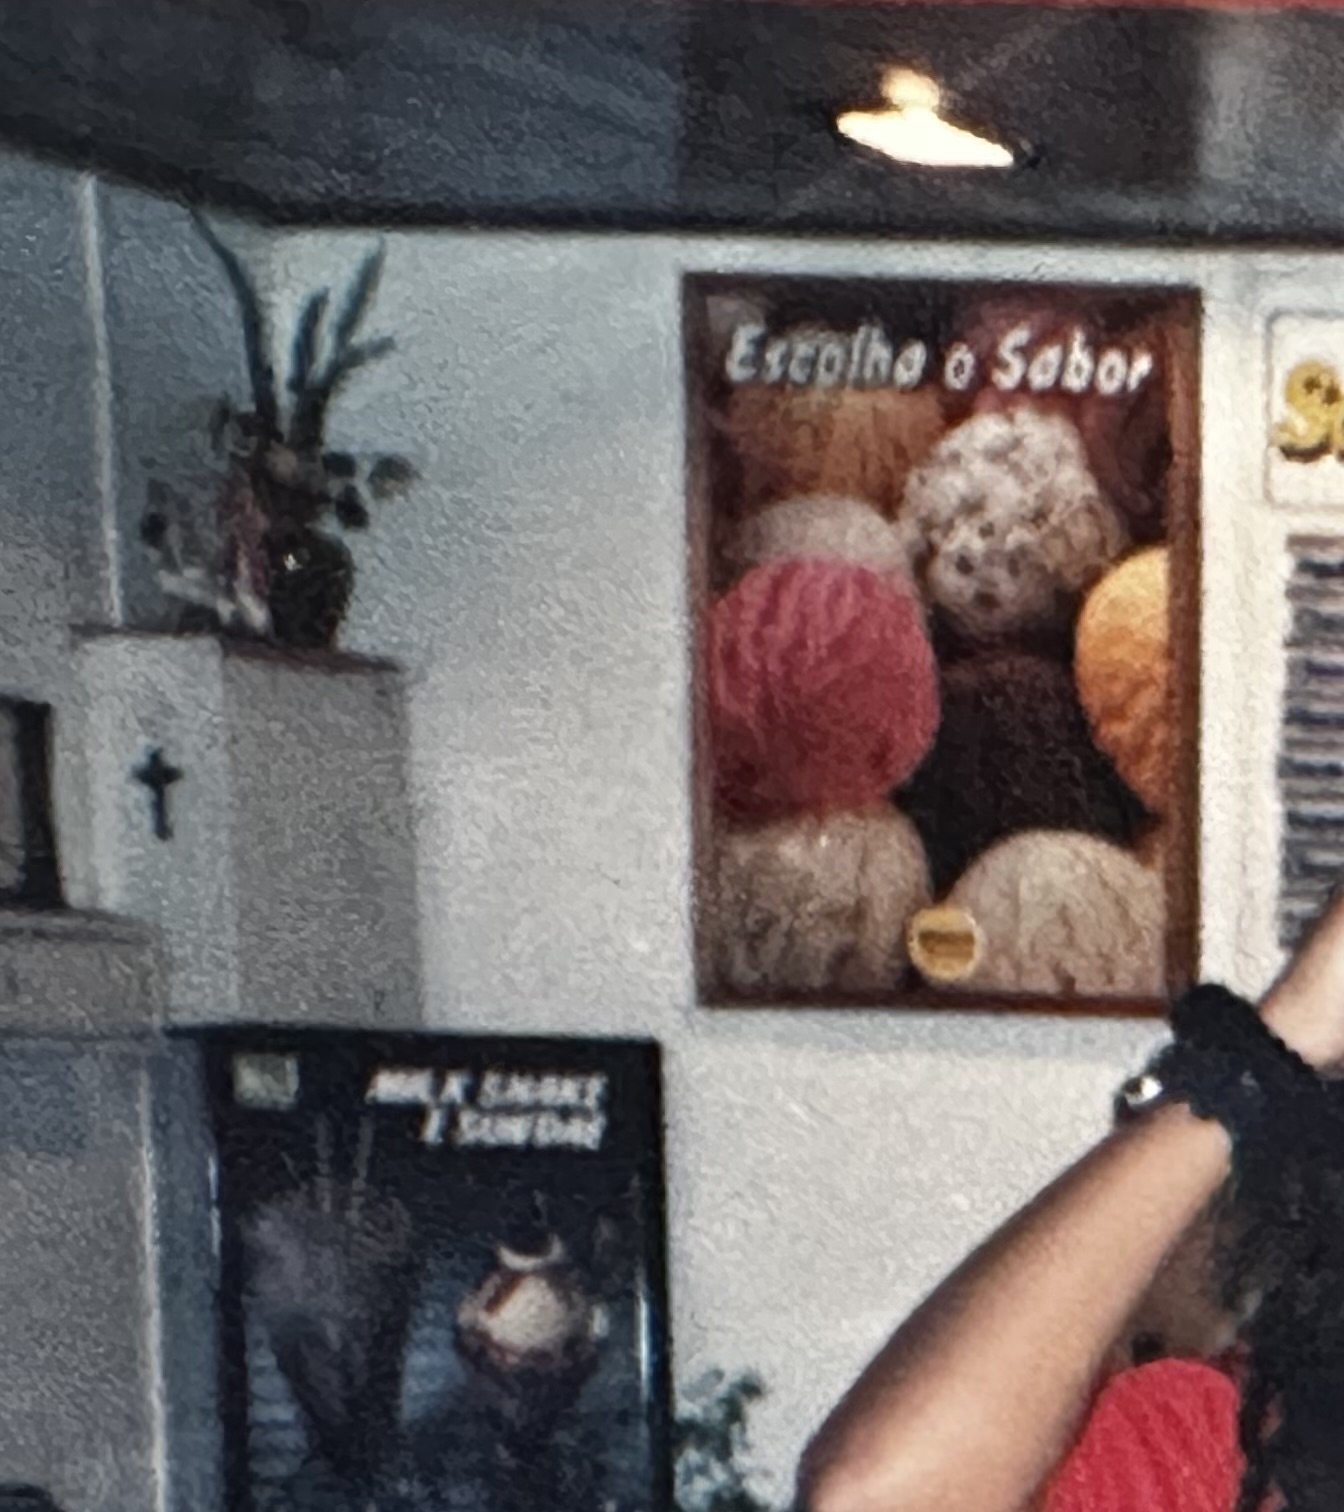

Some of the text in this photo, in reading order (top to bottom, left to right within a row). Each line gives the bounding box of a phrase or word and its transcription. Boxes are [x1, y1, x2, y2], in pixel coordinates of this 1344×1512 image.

[724, 321, 1155, 394] Escolha o Sabor
